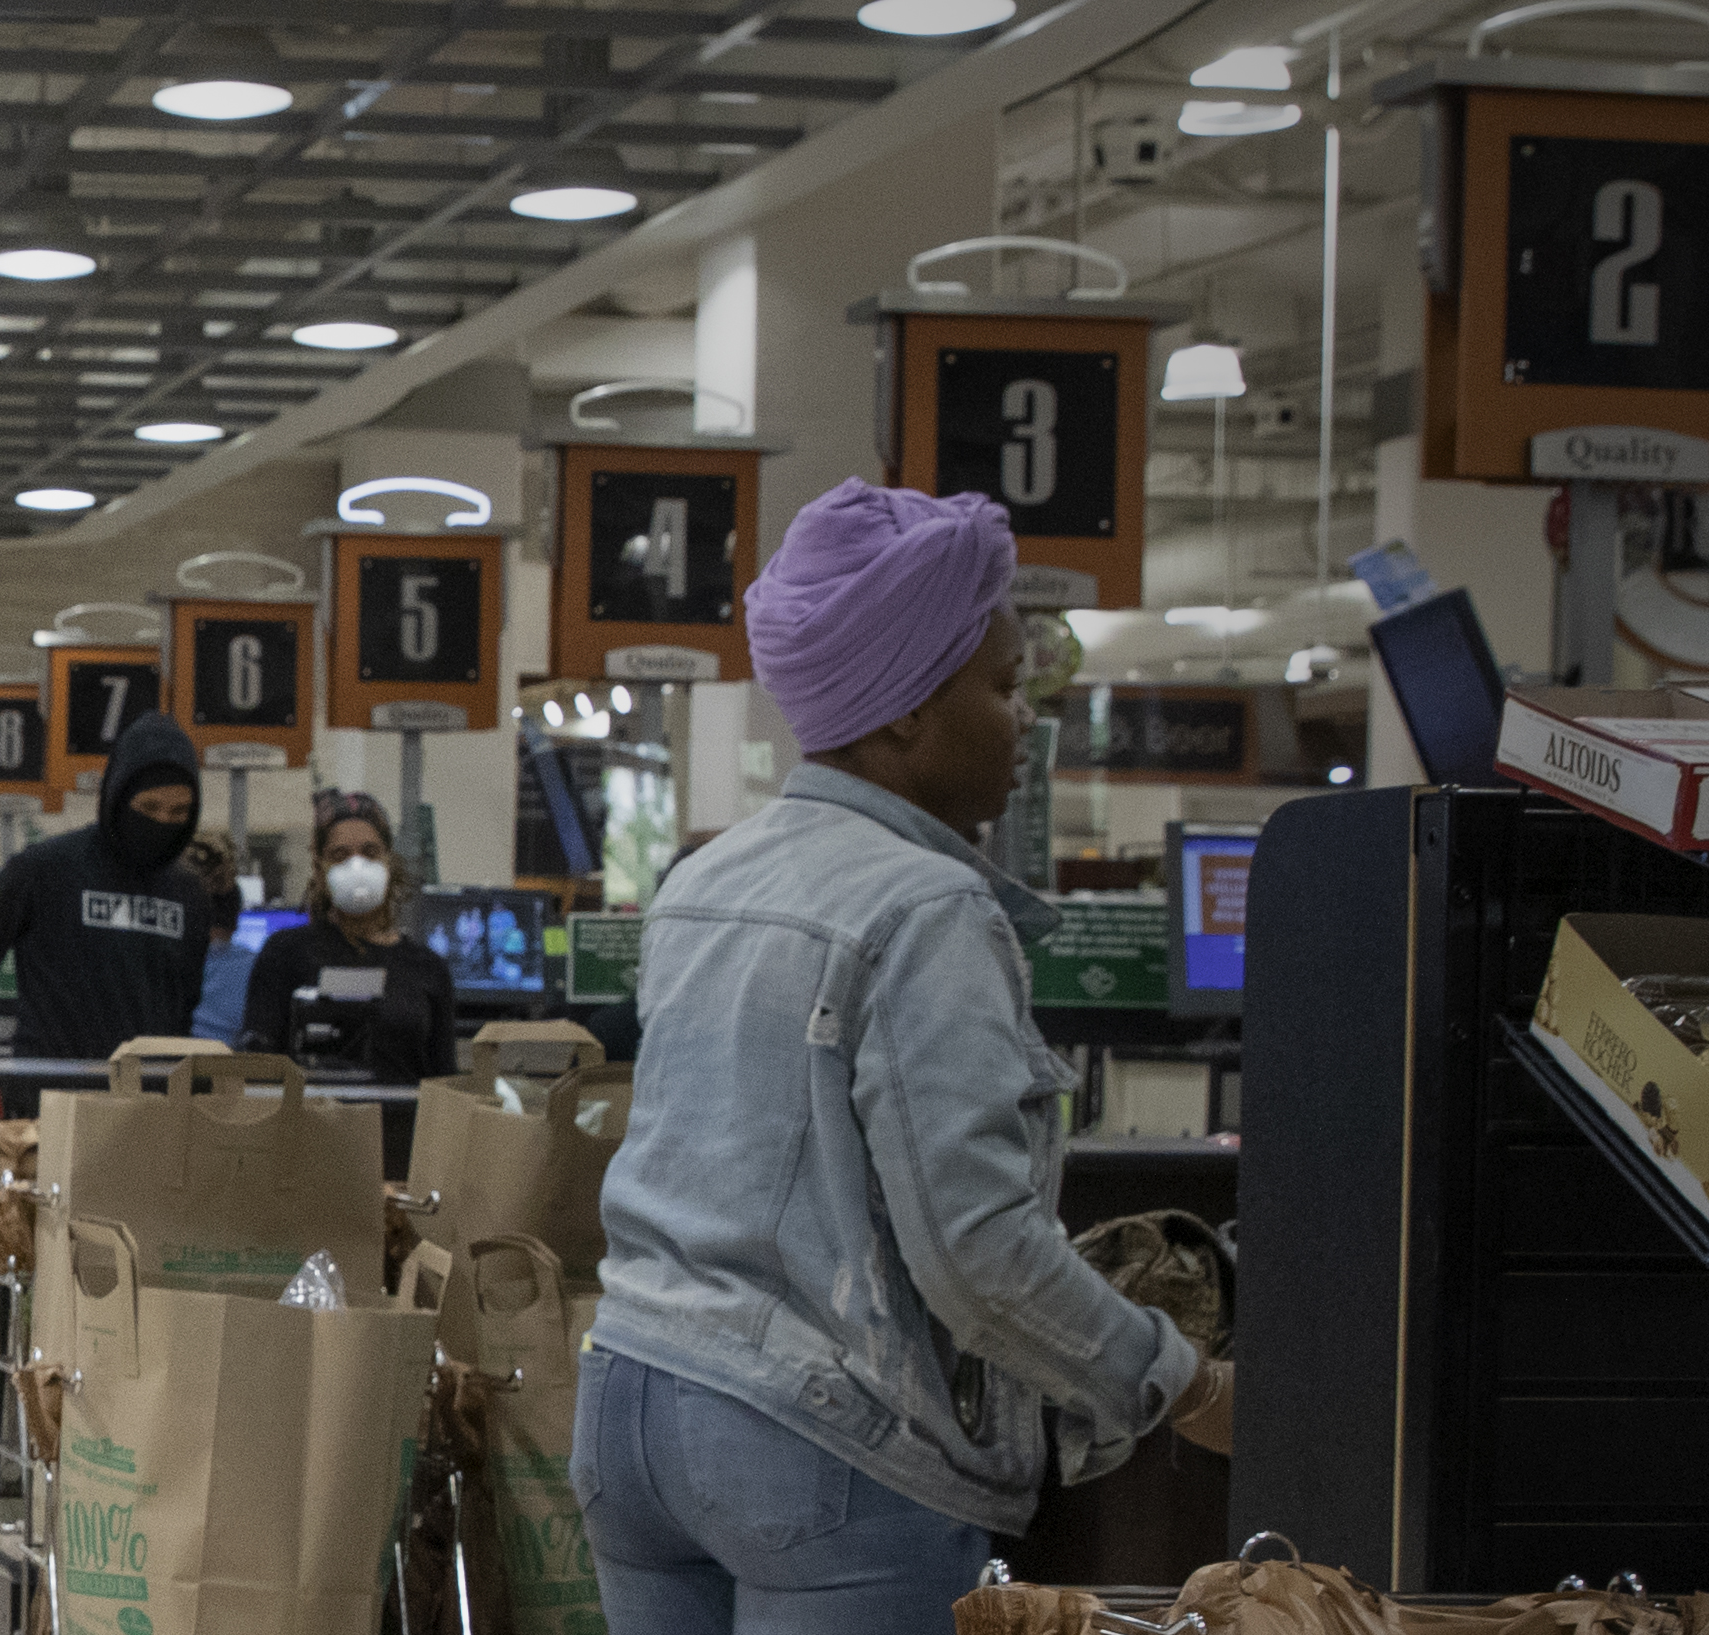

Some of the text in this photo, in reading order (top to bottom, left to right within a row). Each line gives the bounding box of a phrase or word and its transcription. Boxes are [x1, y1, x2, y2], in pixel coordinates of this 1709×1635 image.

[1590, 179, 1663, 345] 2
[1001, 380, 1057, 505] 3
[1565, 434, 1680, 472] Quality
[643, 497, 688, 598] 4
[401, 576, 439, 661] 5
[101, 676, 129, 741] 7
[228, 634, 263, 711] 6
[1544, 732, 1622, 794] ALTOIDS
[1586, 1010, 1638, 1072] FERRERO
[65, 1500, 149, 1572] 100%
